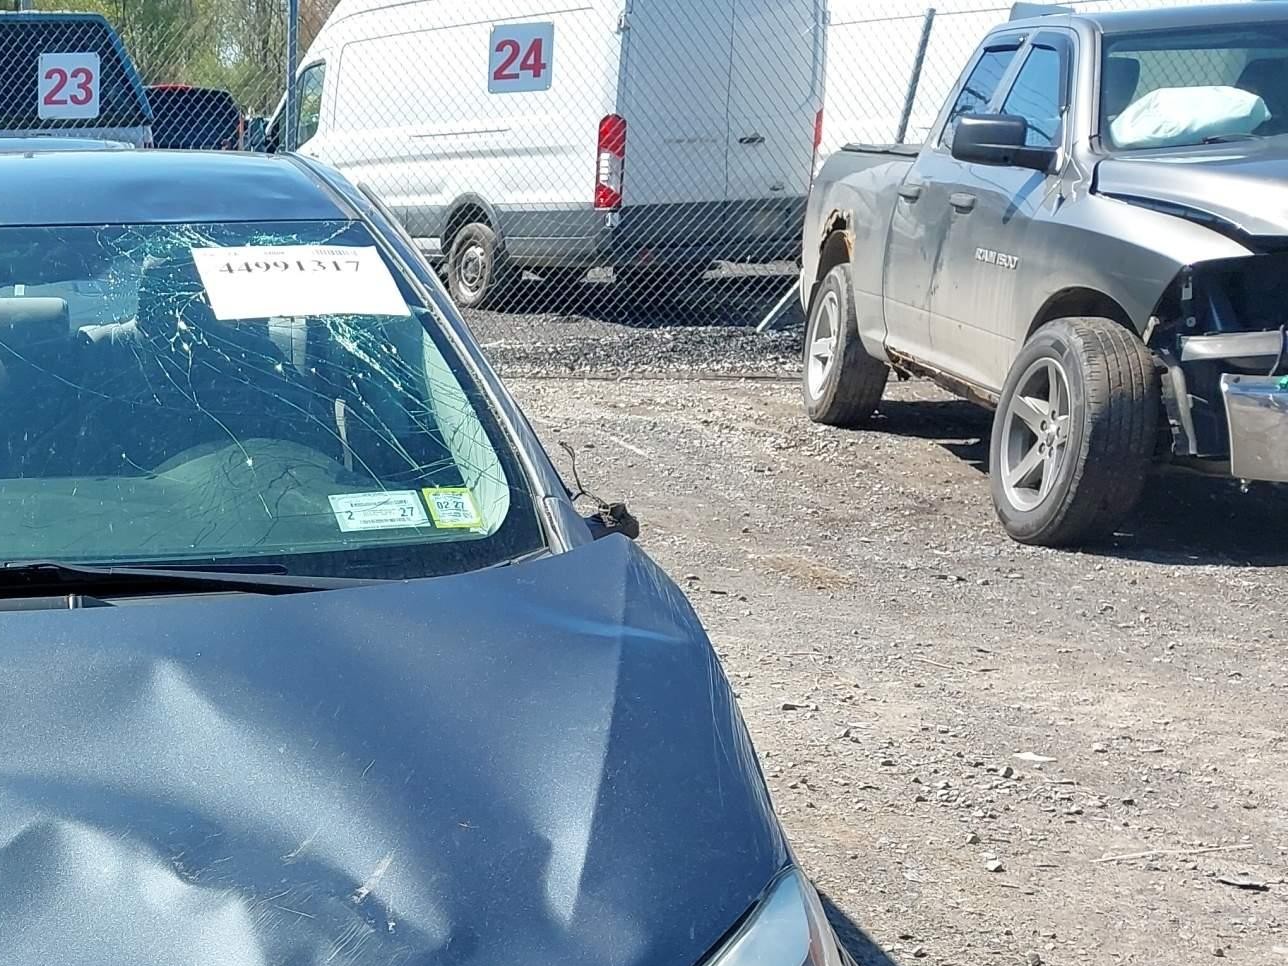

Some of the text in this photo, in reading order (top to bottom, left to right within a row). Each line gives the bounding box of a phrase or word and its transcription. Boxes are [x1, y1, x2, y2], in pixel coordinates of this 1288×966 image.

[493, 37, 546, 80] 24
[43, 67, 93, 105] 23
[218, 260, 361, 274] 44991317
[344, 506, 415, 520] 2 27
